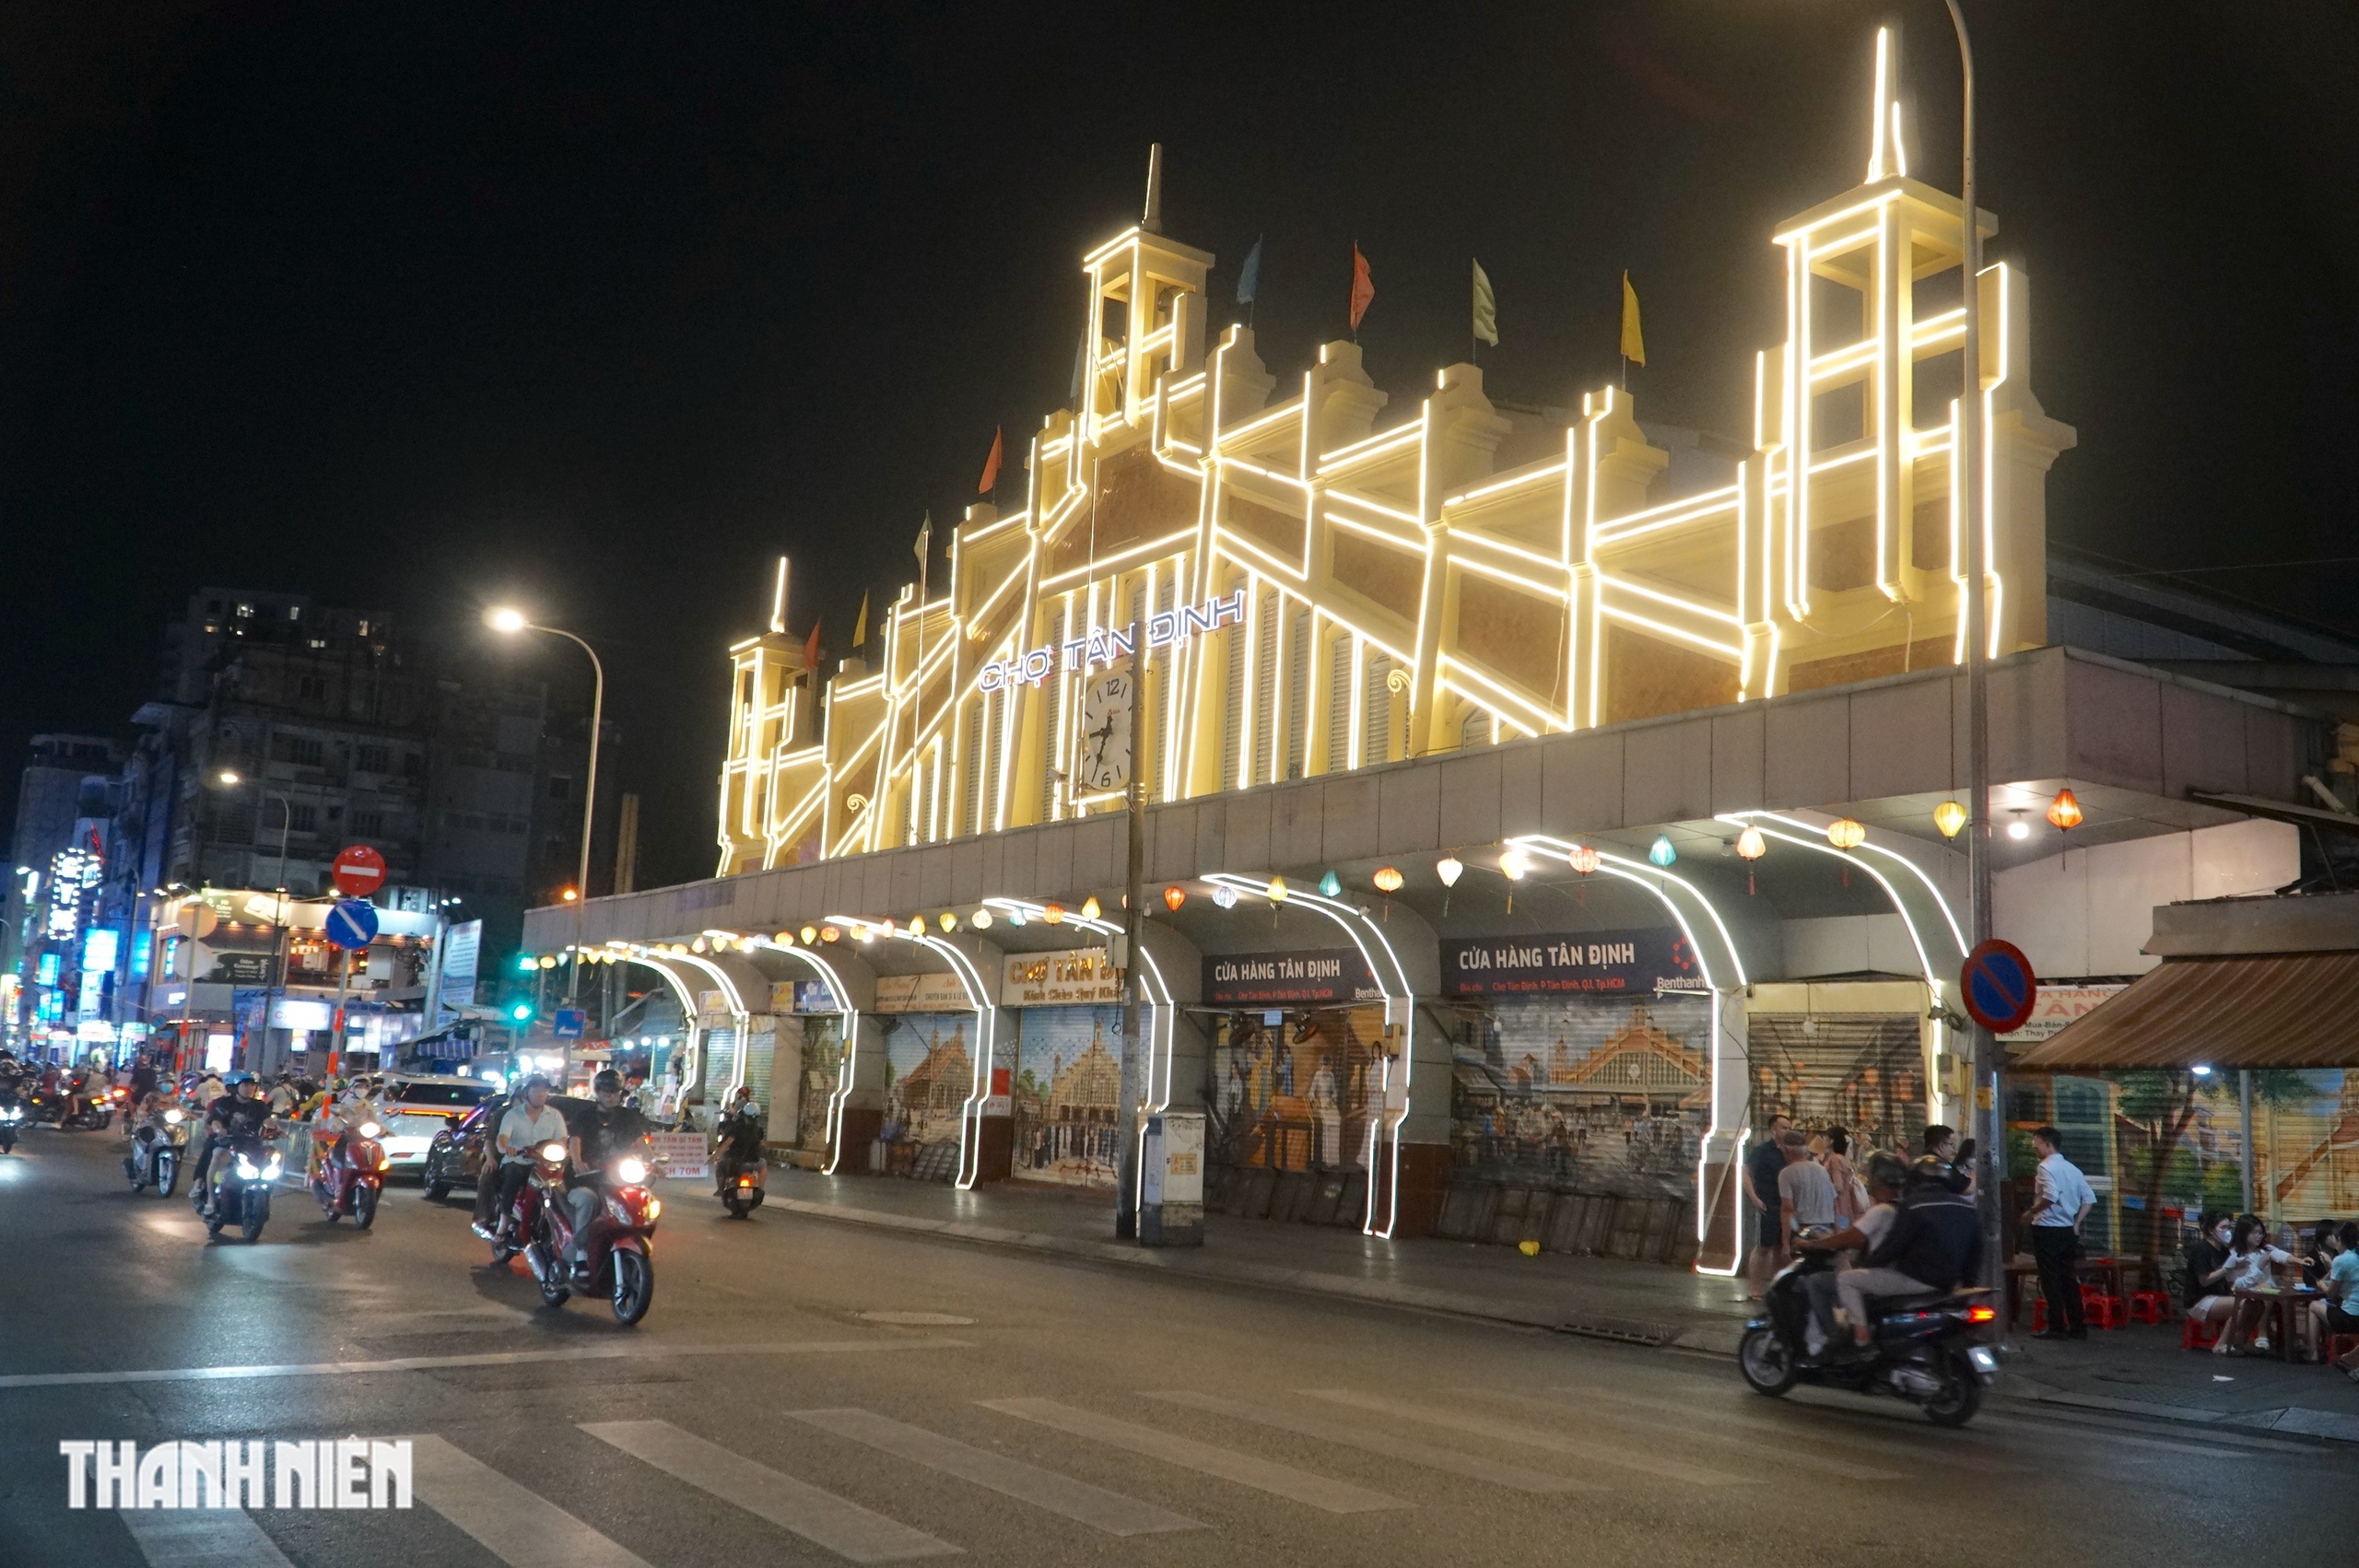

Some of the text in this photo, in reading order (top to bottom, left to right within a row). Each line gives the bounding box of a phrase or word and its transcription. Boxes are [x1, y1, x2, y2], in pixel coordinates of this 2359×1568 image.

[978, 590, 1246, 693] CHỢ TÂN ĐỊNH
[1106, 678, 1120, 696] 12
[1100, 771, 1111, 788] 6
[1053, 951, 1094, 982] TÂN
[1459, 942, 1636, 970] CỬA HÀNG TÂN ĐỊNH
[1215, 957, 1341, 982] CỬA HÀNG TÂN ĐỊNH
[1657, 976, 1705, 989] Benthanh
